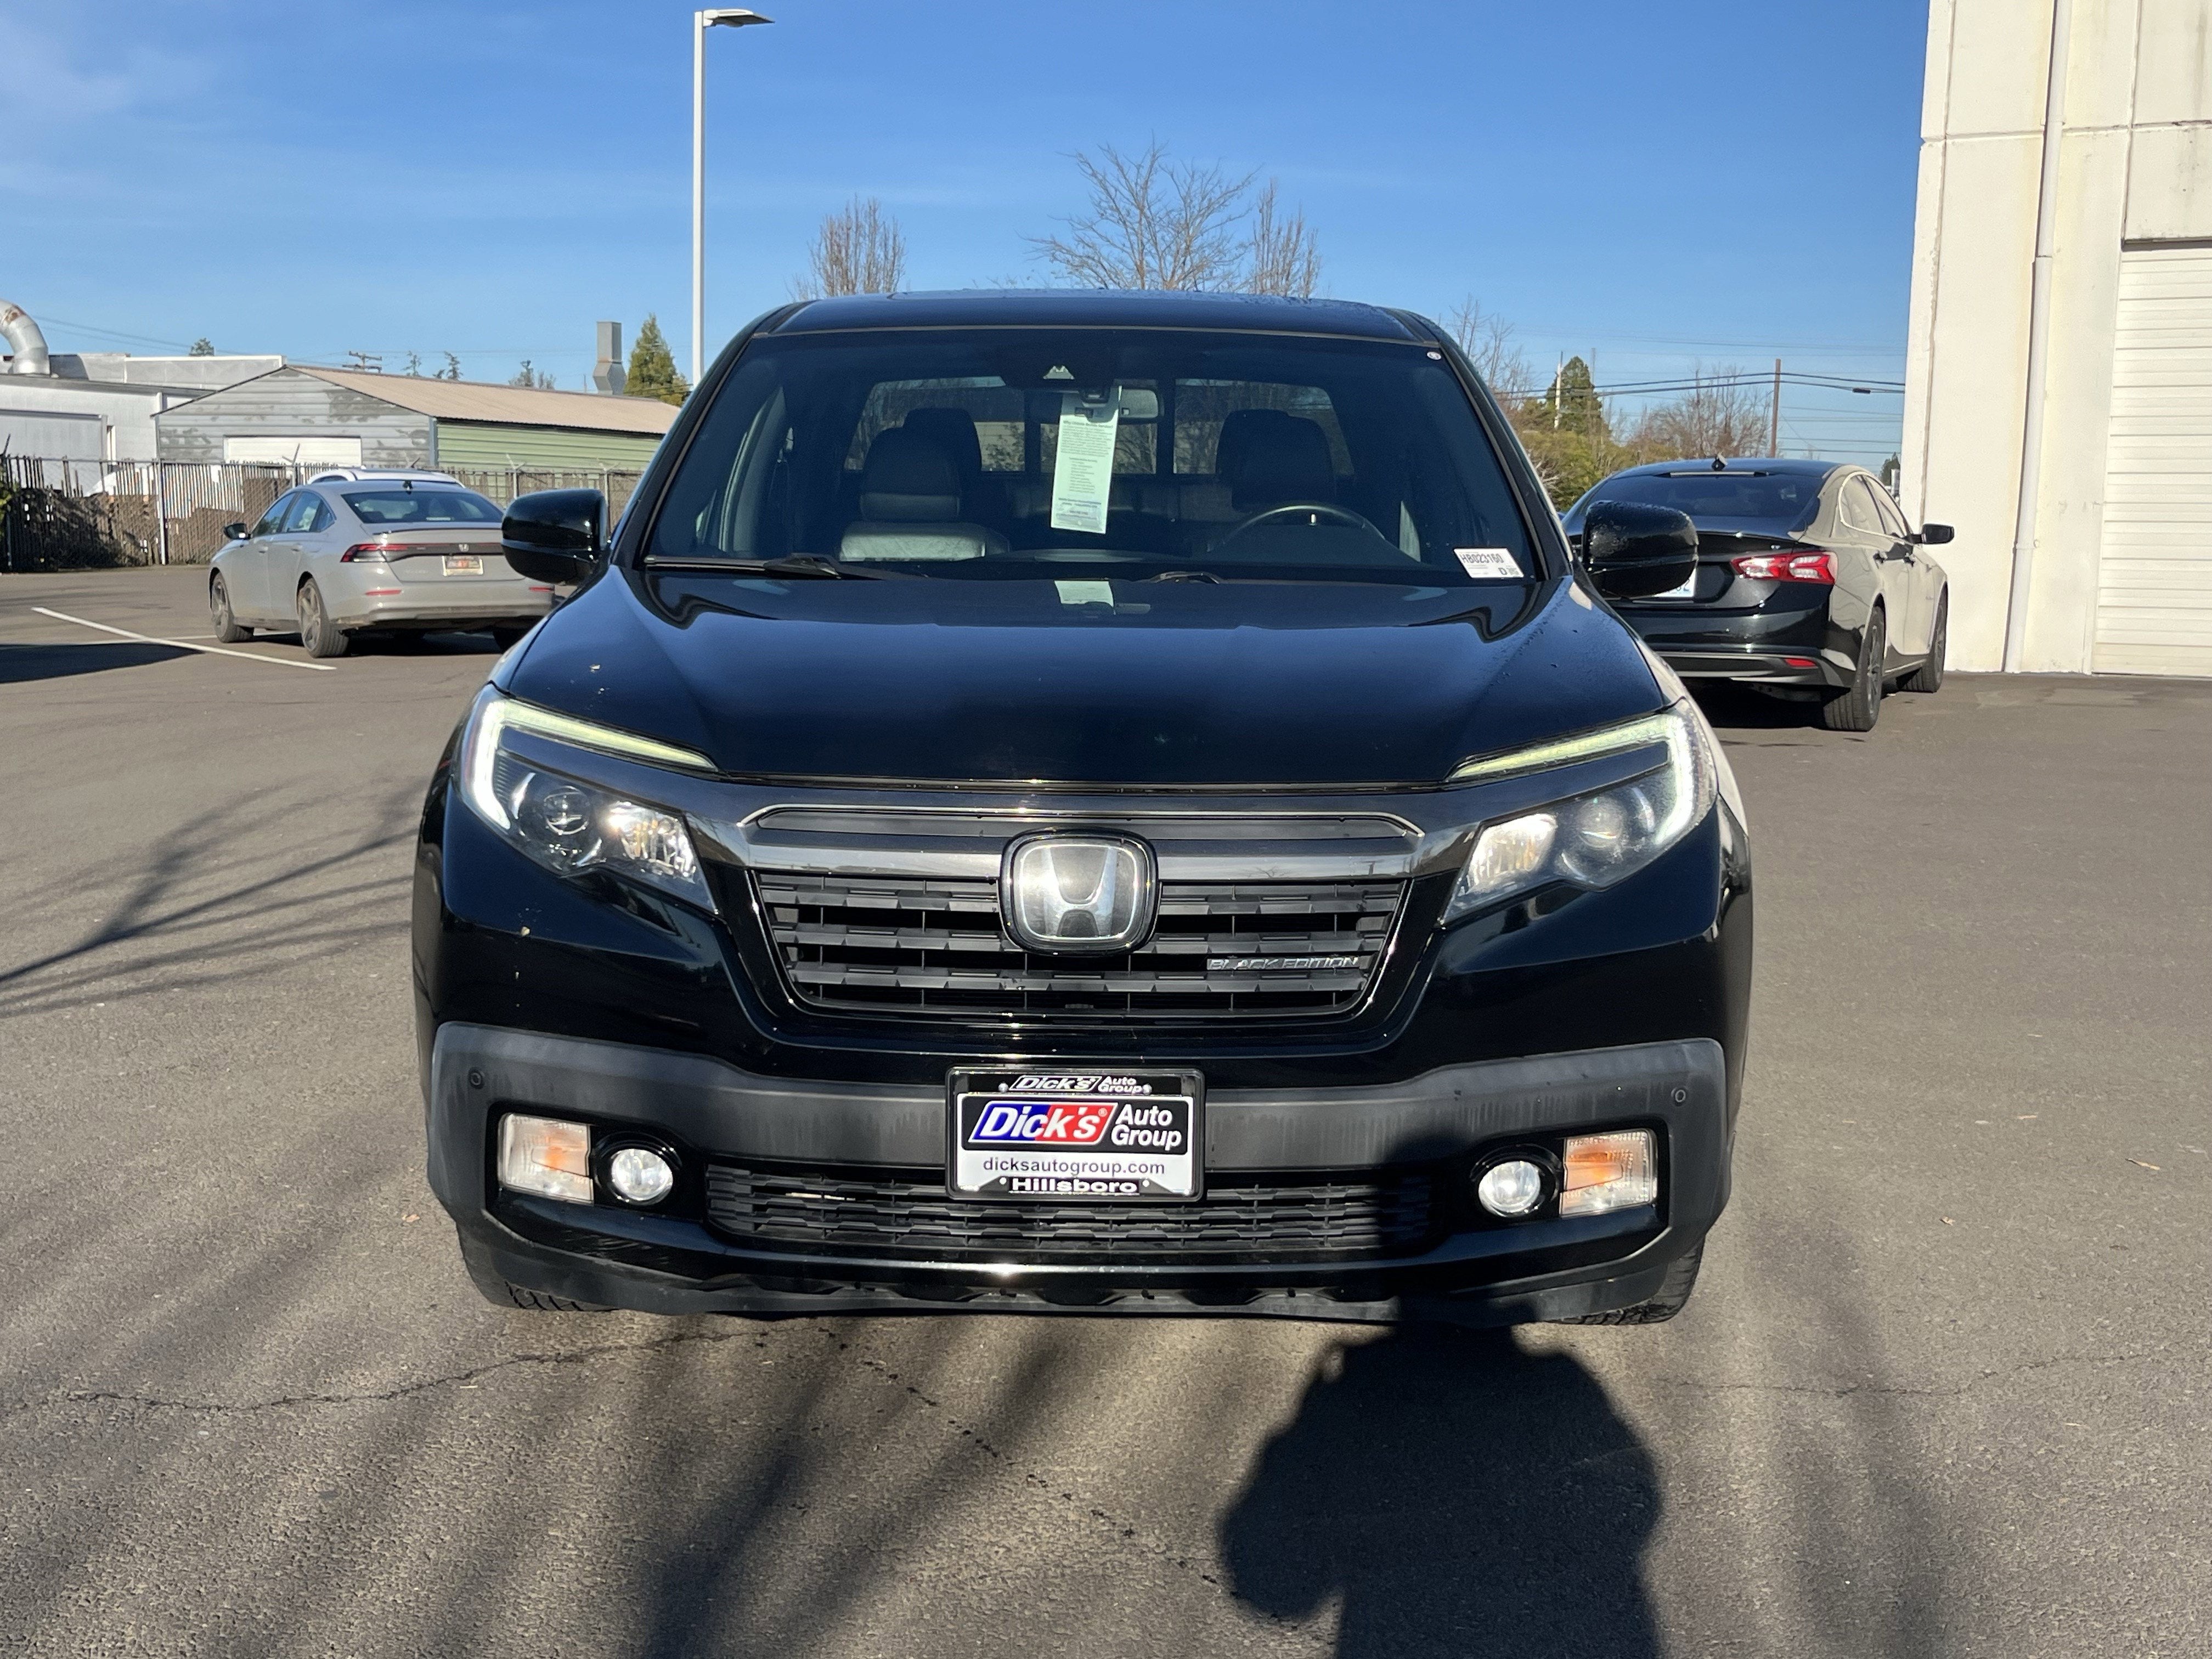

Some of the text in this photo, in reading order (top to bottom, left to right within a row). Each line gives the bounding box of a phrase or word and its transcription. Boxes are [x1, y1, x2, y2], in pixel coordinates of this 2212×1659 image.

[1209, 957, 1359, 969] BLACK EDITION
[1101, 1076, 1137, 1085] Auto
[1098, 1084, 1142, 1094] Group
[1115, 1103, 1173, 1127] Auto
[1111, 1126, 1182, 1151] Group
[983, 1157, 1165, 1176] dicksautogroup.com
[1012, 1178, 1138, 1193] Hillsboro
